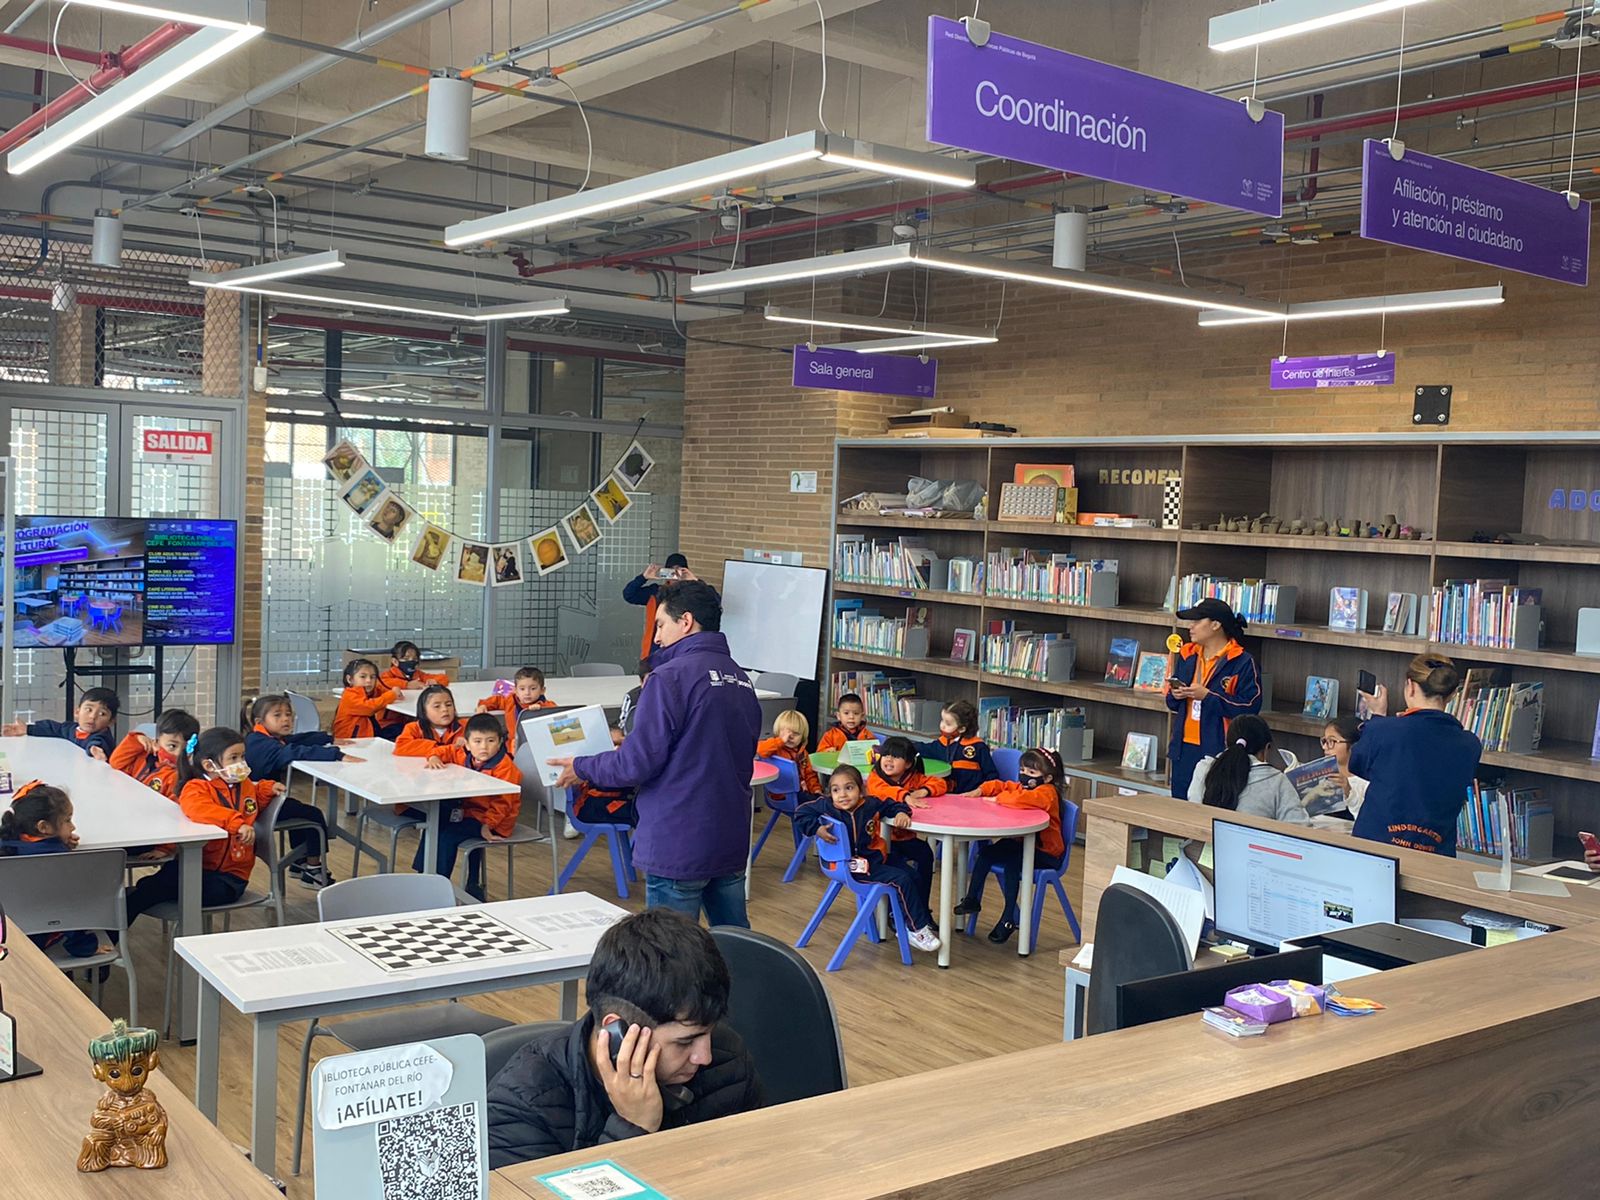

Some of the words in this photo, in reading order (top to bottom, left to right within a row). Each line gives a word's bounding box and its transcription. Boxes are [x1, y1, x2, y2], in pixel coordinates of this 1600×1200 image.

[975, 80, 1147, 153] Coordinación
[1393, 176, 1449, 211] Afiliación,
[1451, 194, 1504, 222] préstamo
[1392, 207, 1401, 228] y
[1402, 209, 1453, 236] atención
[1455, 220, 1466, 240] al
[1467, 223, 1524, 253] ciudadano
[809, 360, 834, 376] Sala
[835, 366, 875, 380] general
[1281, 369, 1311, 380] Centro
[146, 433, 209, 452] SALIDA
[15, 520, 90, 539] OGRAMACIÓN
[373, 1059, 411, 1074] PÚBLICA
[413, 1054, 438, 1067] CEFE-
[335, 1078, 386, 1097] FONTANAR
[388, 1075, 405, 1087] DEL
[407, 1071, 423, 1082] RÍO
[337, 1089, 423, 1124] ¡AFÍLIATE!
